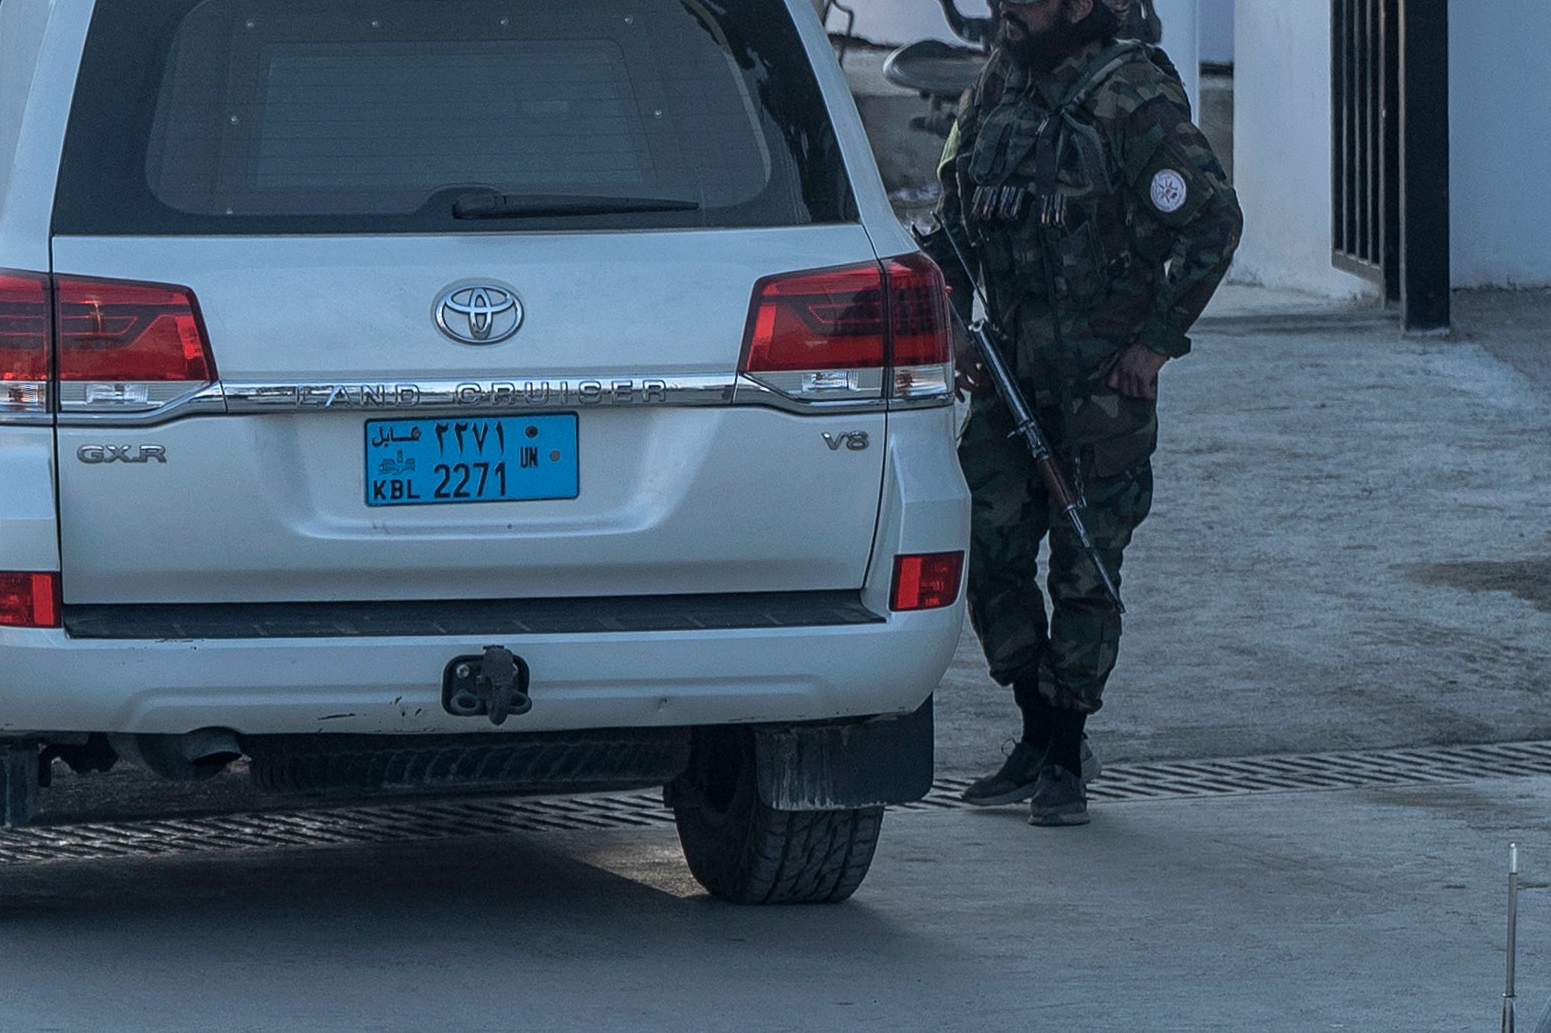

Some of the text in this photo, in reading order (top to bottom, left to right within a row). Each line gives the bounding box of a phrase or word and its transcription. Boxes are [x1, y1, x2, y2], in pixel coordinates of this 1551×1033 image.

[296, 379, 667, 408] LAND CRUISER
[821, 430, 870, 451] V8
[520, 447, 538, 468] UN
[373, 462, 506, 500] KBL 2271
